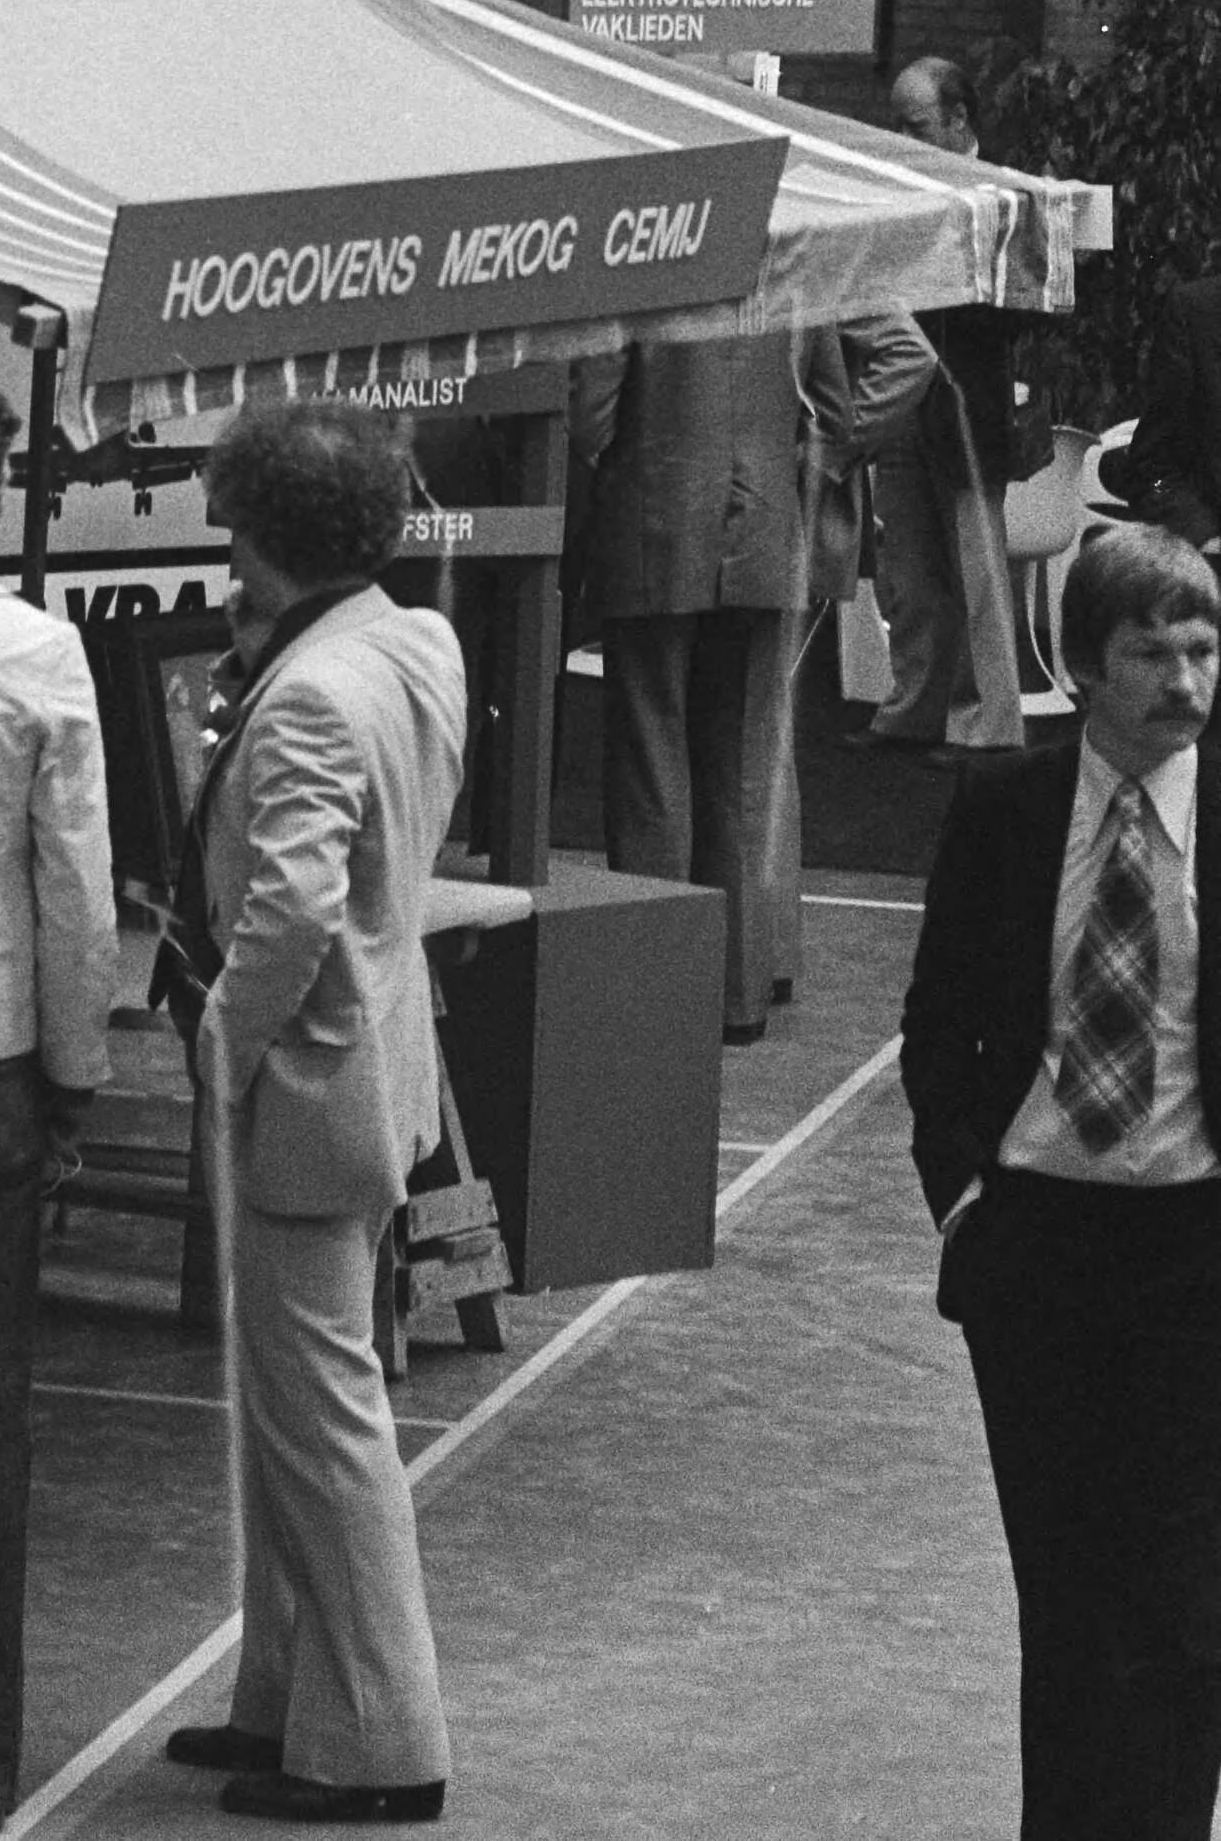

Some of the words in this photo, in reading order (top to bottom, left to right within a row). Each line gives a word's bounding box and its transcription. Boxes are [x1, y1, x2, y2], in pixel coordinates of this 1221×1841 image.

[582, 14, 704, 41] VAKLIEDEN
[161, 234, 422, 322] HOOGOVENS
[437, 215, 578, 288] MEKOG
[603, 198, 713, 268] CEMIJ
